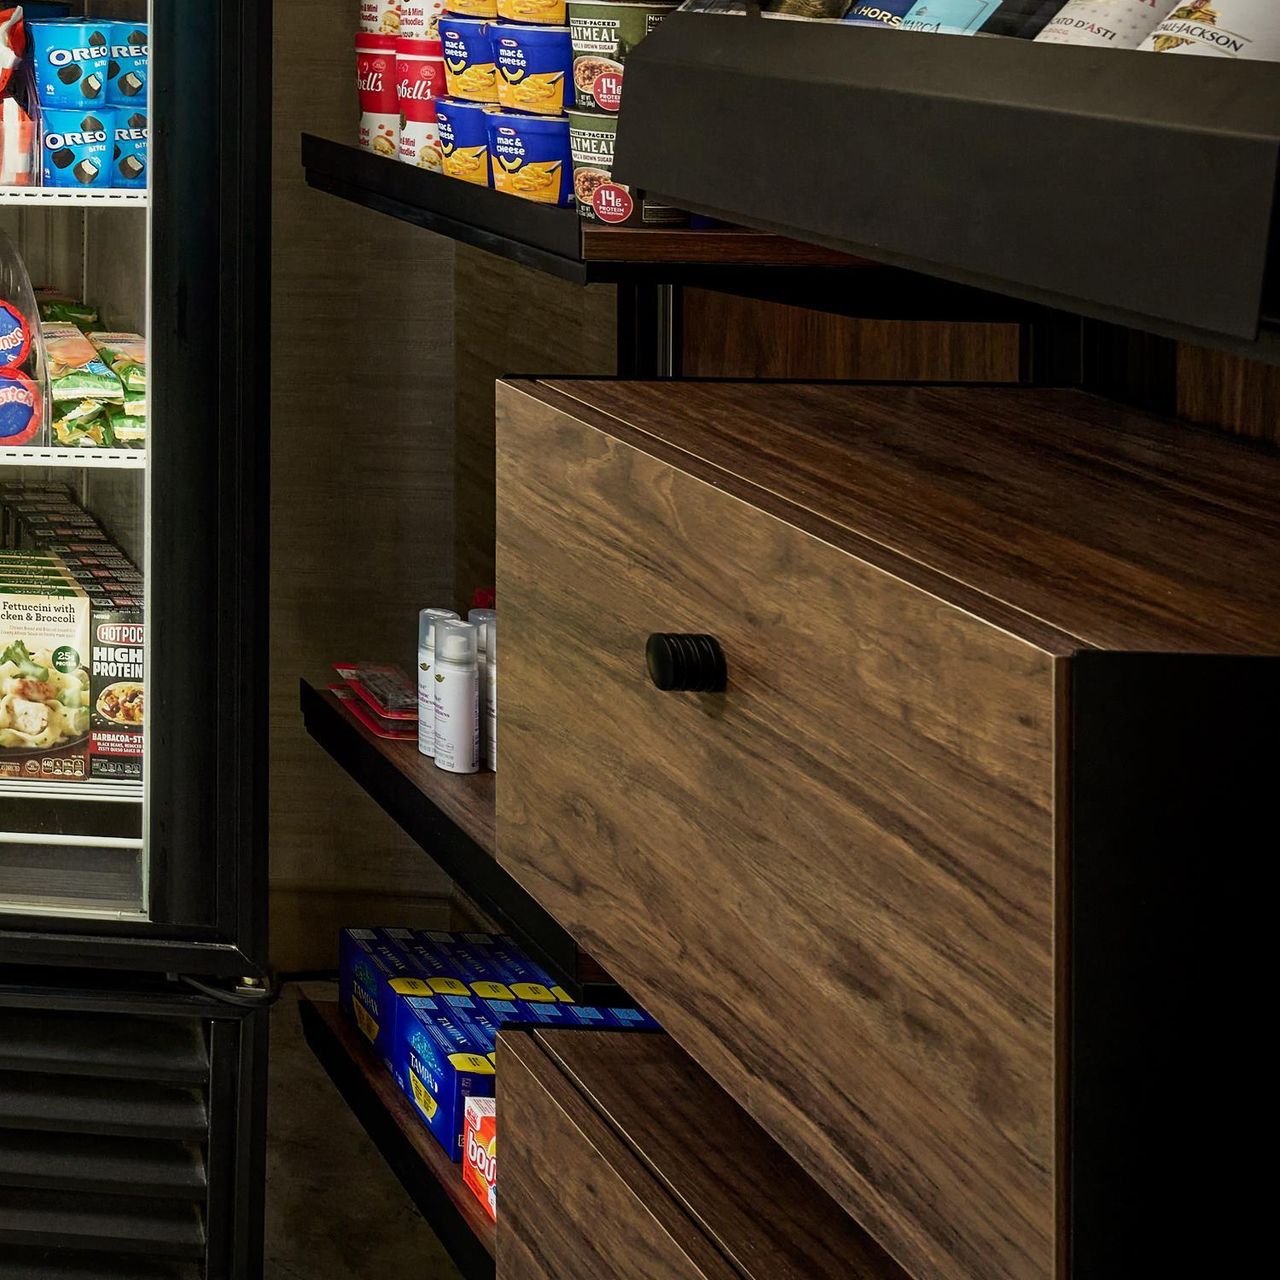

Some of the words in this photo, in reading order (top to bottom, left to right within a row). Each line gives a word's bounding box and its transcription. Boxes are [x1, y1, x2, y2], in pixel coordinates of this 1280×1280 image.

[49, 46, 108, 65] OREO
[500, 49, 515, 57] mac
[517, 50, 523, 58] &
[46, 131, 107, 148] OREO
[497, 137, 512, 145] mac
[515, 138, 522, 146] &
[600, 190, 621, 207] 14g
[2, 602, 52, 612] Fettuccini
[54, 604, 75, 613] with
[93, 647, 142, 663] HIGH
[93, 662, 142, 678] PROTEIN
